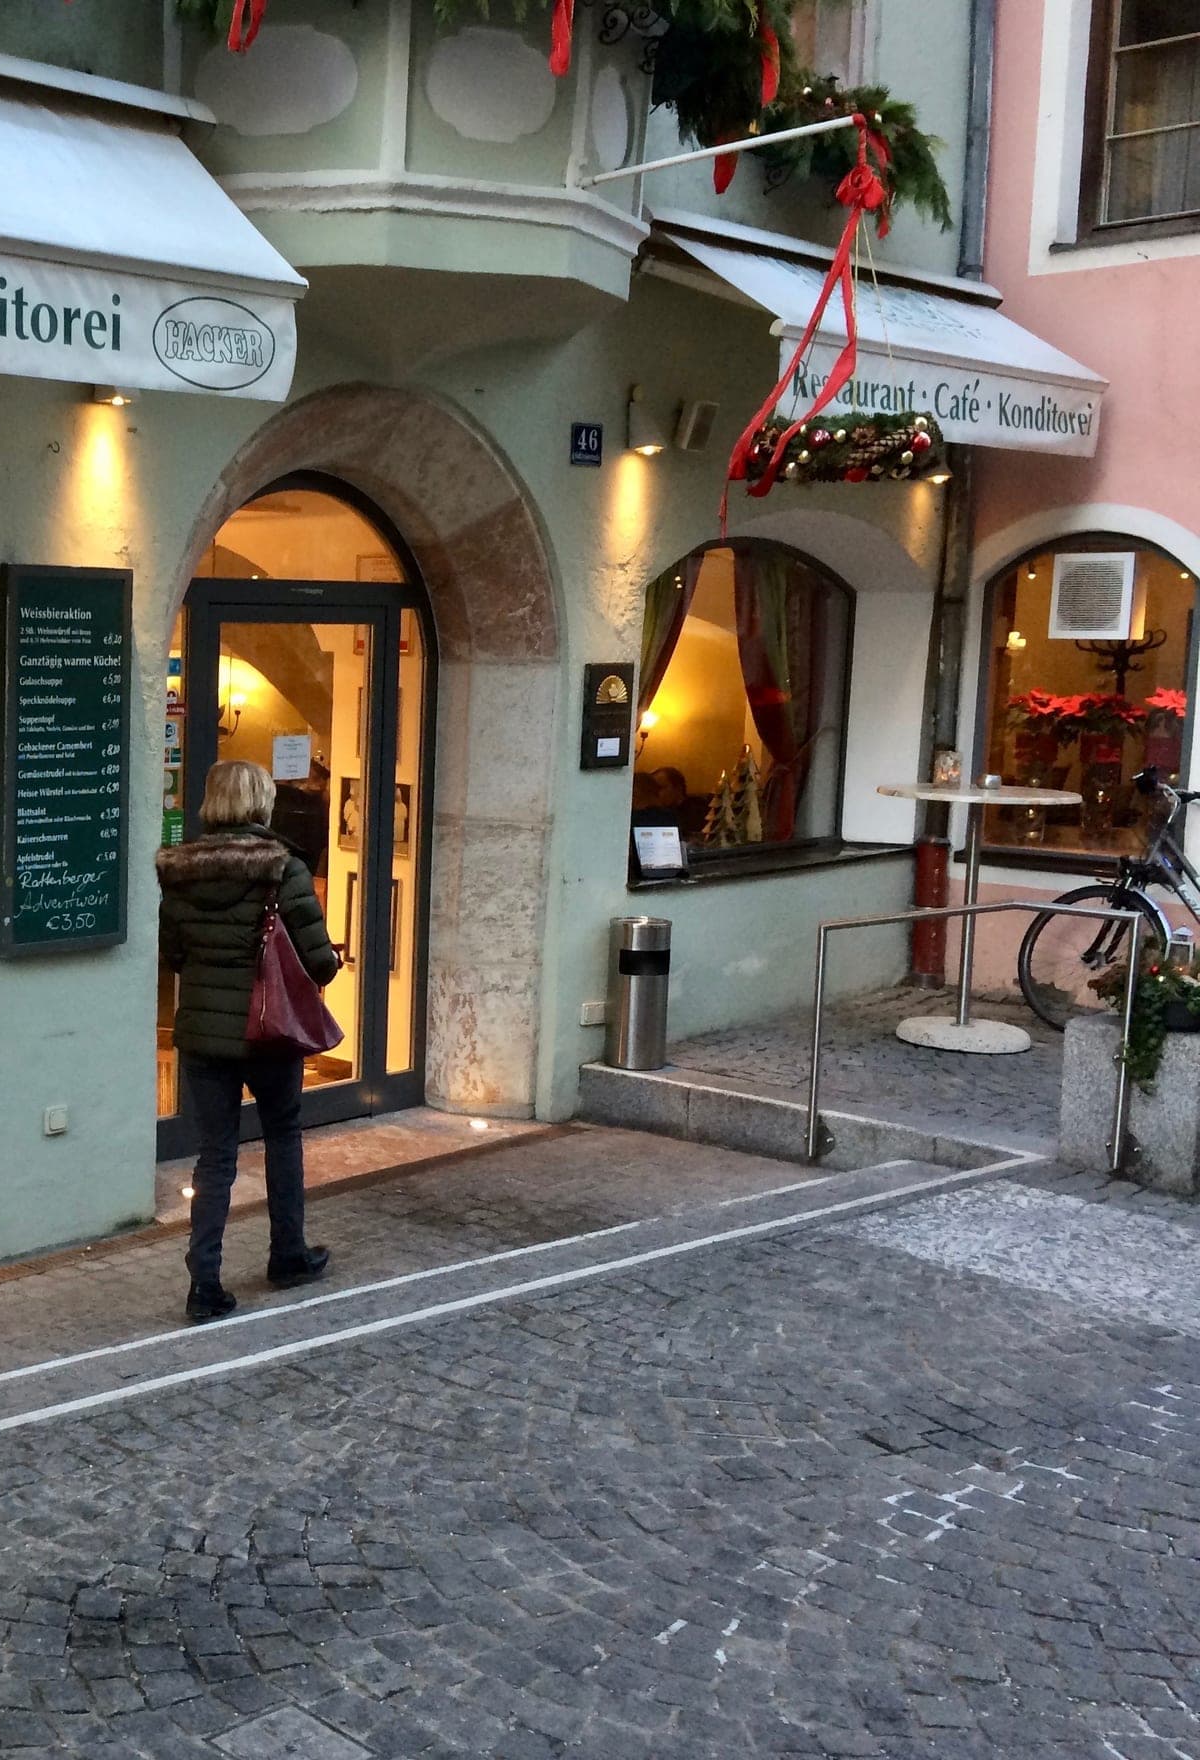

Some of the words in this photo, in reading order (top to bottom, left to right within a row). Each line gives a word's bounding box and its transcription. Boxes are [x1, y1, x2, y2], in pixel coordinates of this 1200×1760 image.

[165, 320, 263, 368] HACKER
[934, 379, 980, 423] Café
[999, 392, 1093, 436] Konditorei
[577, 428, 598, 451] 46
[20, 607, 92, 620] Weissbieraktion
[19, 655, 62, 669] Ganztägig
[64, 657, 92, 666] warme
[93, 655, 121, 666] Küche!
